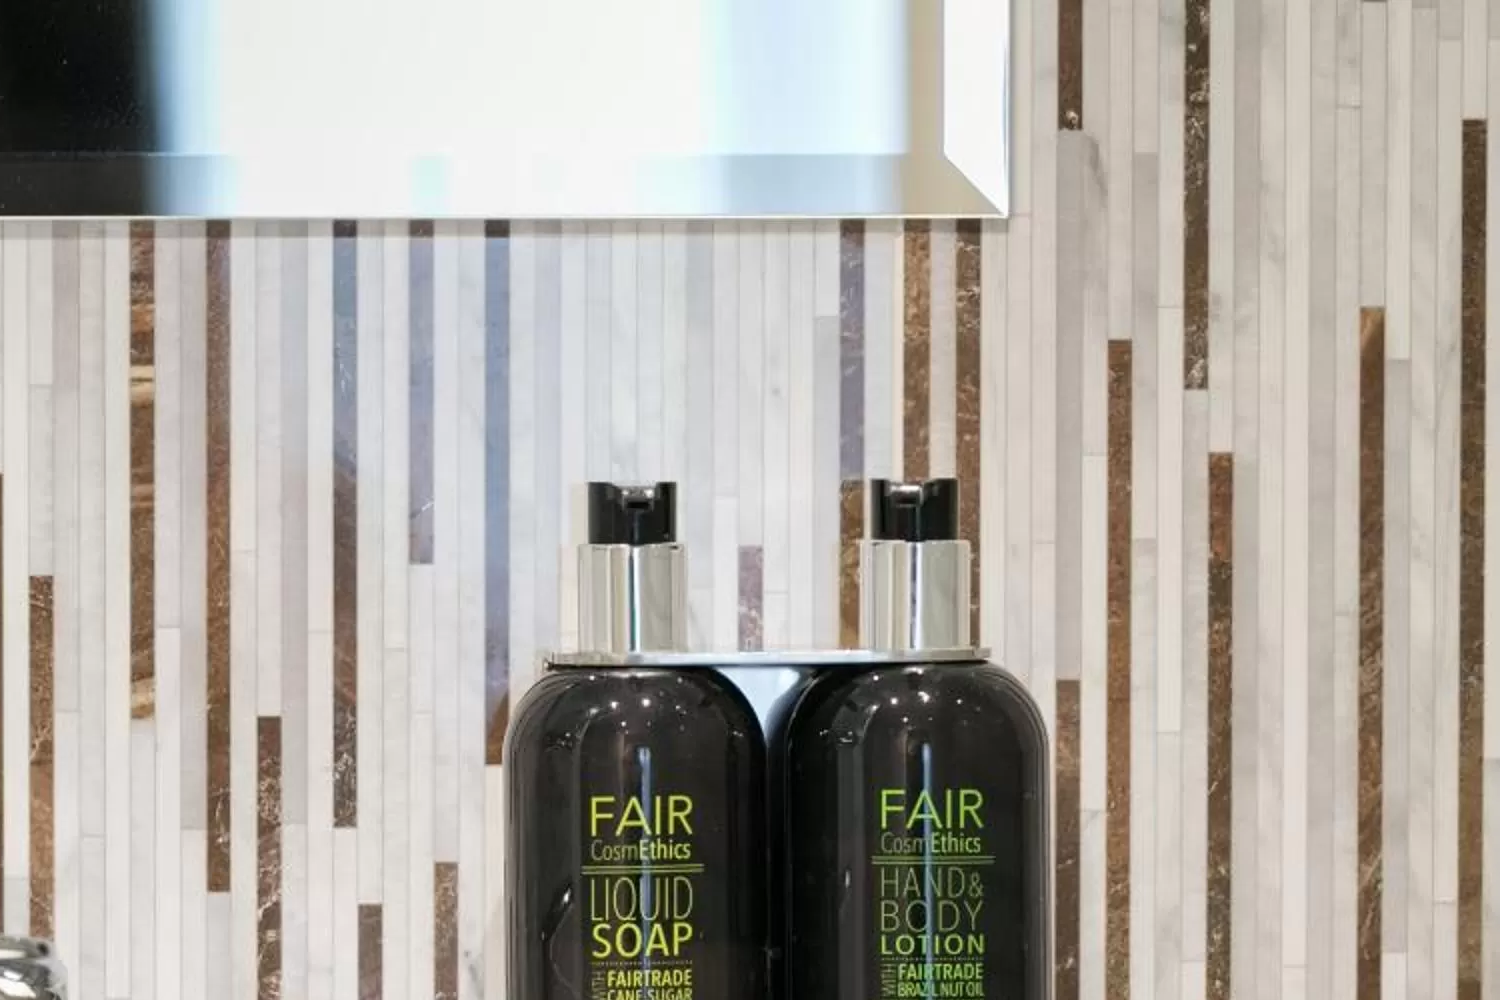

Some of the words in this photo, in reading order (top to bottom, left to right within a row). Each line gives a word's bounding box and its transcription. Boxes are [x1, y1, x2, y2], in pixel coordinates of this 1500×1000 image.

[591, 795, 693, 836] FAIR
[881, 789, 984, 829] FAIR
[591, 838, 692, 861] CosmEthics
[881, 831, 982, 853] CosmEthics
[591, 876, 694, 921] LIQUID
[881, 900, 984, 932] BODY
[592, 922, 694, 958] SOAP
[881, 933, 985, 956] LOTION
[607, 968, 693, 988] FAIRTRADE
[897, 963, 985, 981] FAIRTRADE
[897, 981, 939, 997] BRAZL
[940, 981, 965, 997] NUT
[965, 981, 986, 998] OIL
